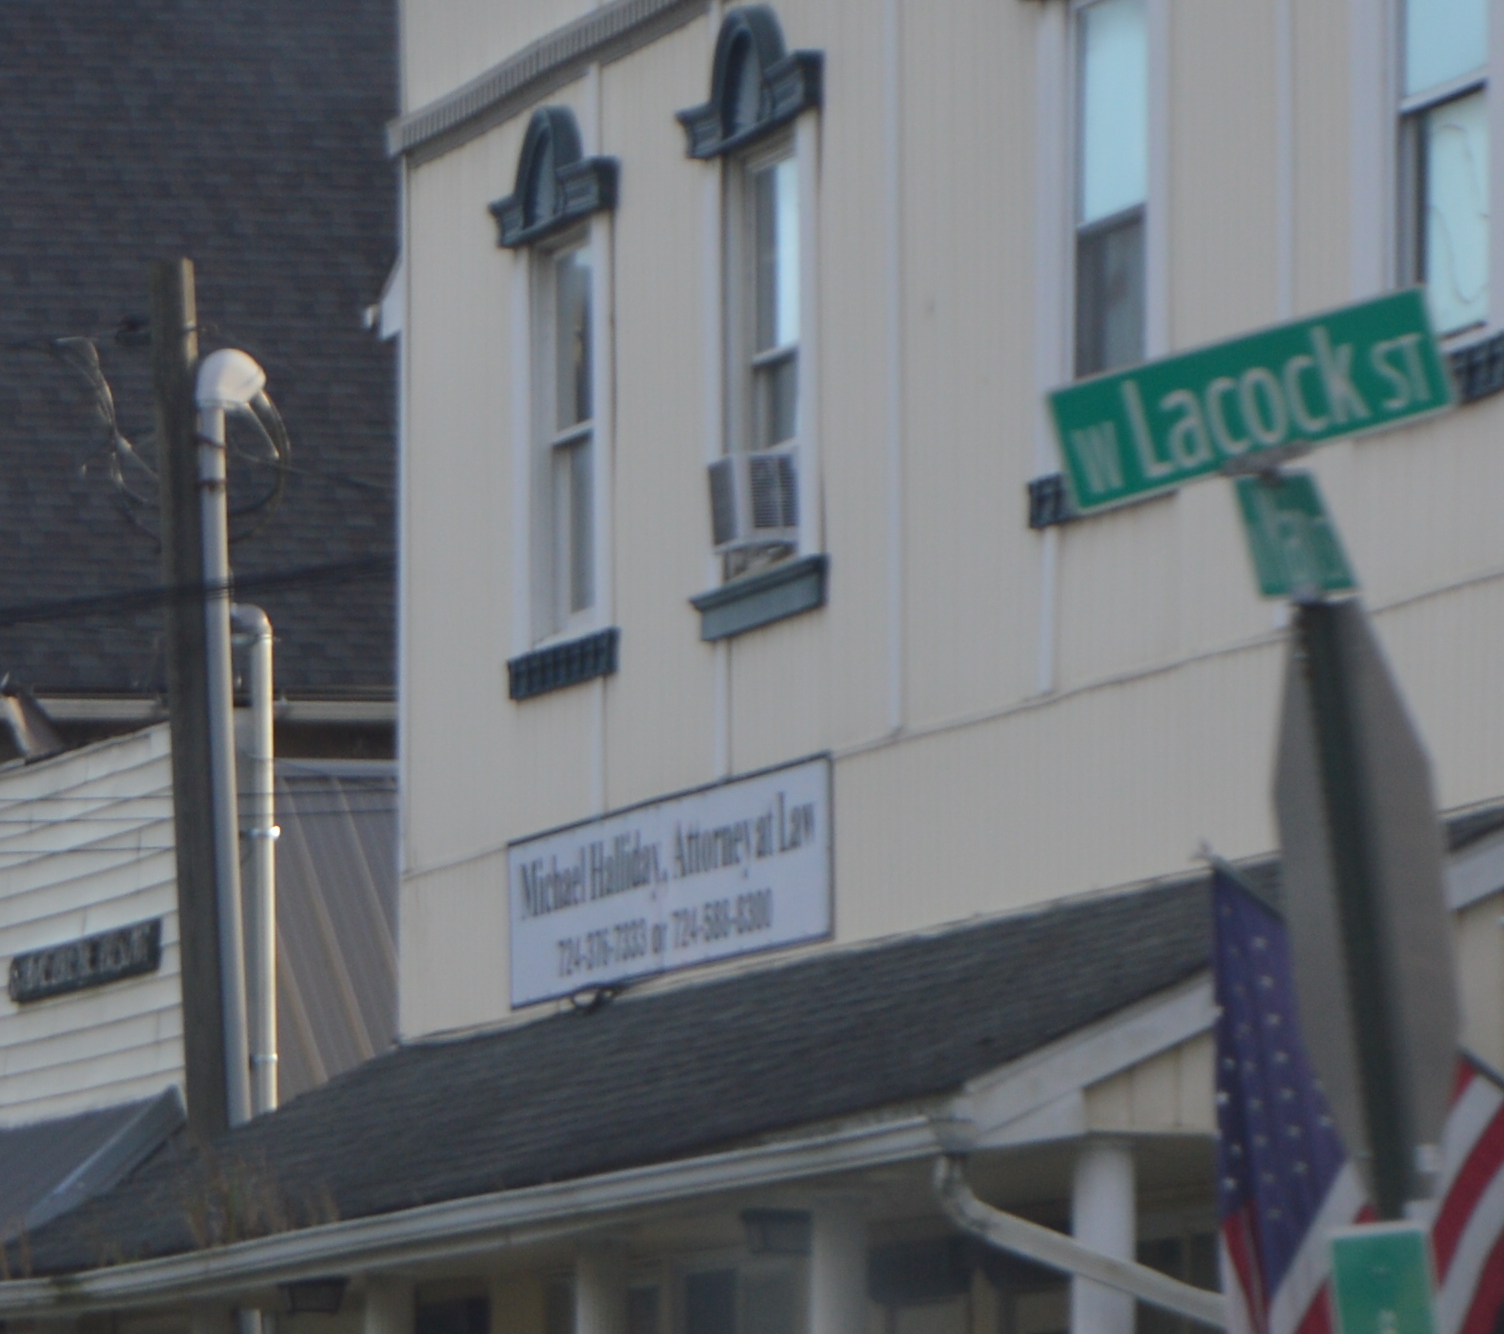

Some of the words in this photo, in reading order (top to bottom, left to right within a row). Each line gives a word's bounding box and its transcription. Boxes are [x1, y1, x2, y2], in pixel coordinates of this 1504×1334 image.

[1119, 324, 1372, 482] Lacock
[1369, 331, 1435, 411] ST
[519, 843, 587, 920] Michael
[672, 818, 752, 880] Attorney
[755, 809, 774, 860] at
[775, 789, 816, 854] Law
[651, 922, 668, 955] or
